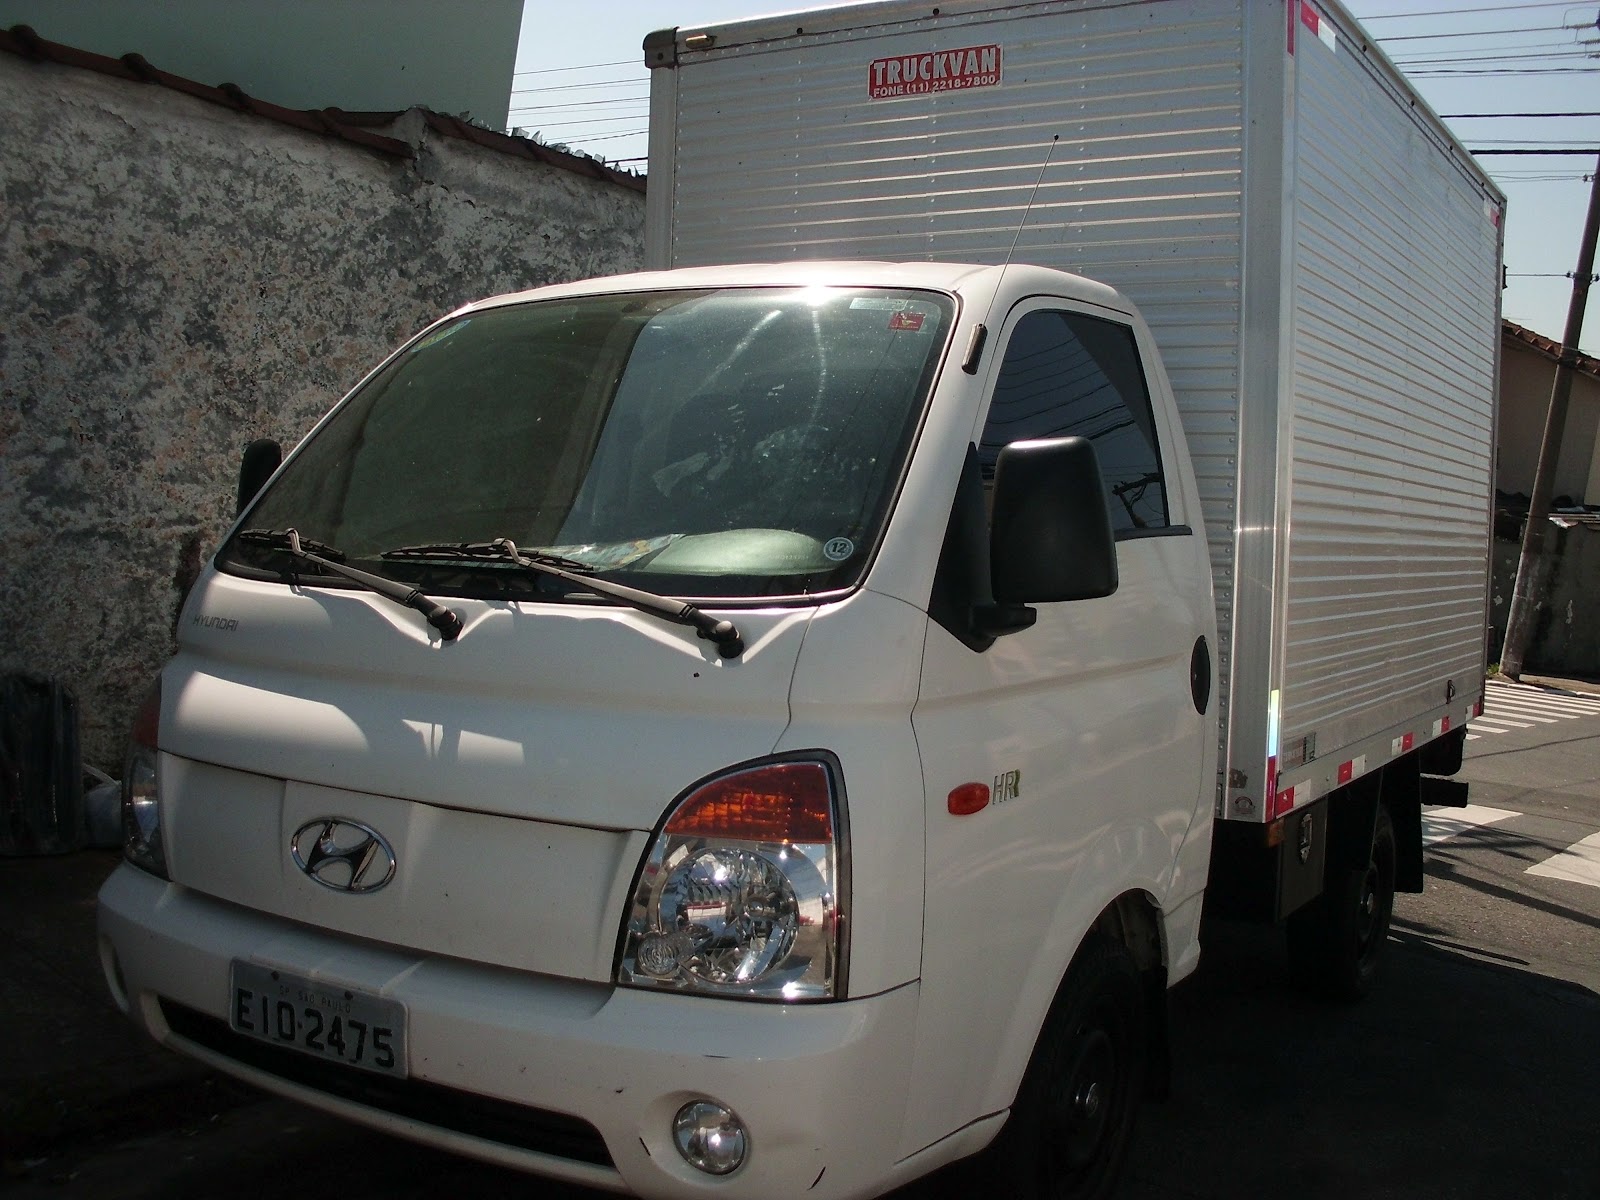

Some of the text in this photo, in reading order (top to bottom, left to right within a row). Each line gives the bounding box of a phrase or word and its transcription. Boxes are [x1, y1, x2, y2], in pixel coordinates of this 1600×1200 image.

[873, 47, 996, 86] TRUCKVAN
[873, 74, 996, 98] FONE (11) 2218-7800
[832, 541, 847, 554] 12
[192, 614, 240, 631] HYUNDAI
[992, 769, 1021, 805] HR
[321, 996, 351, 1014] PAULO
